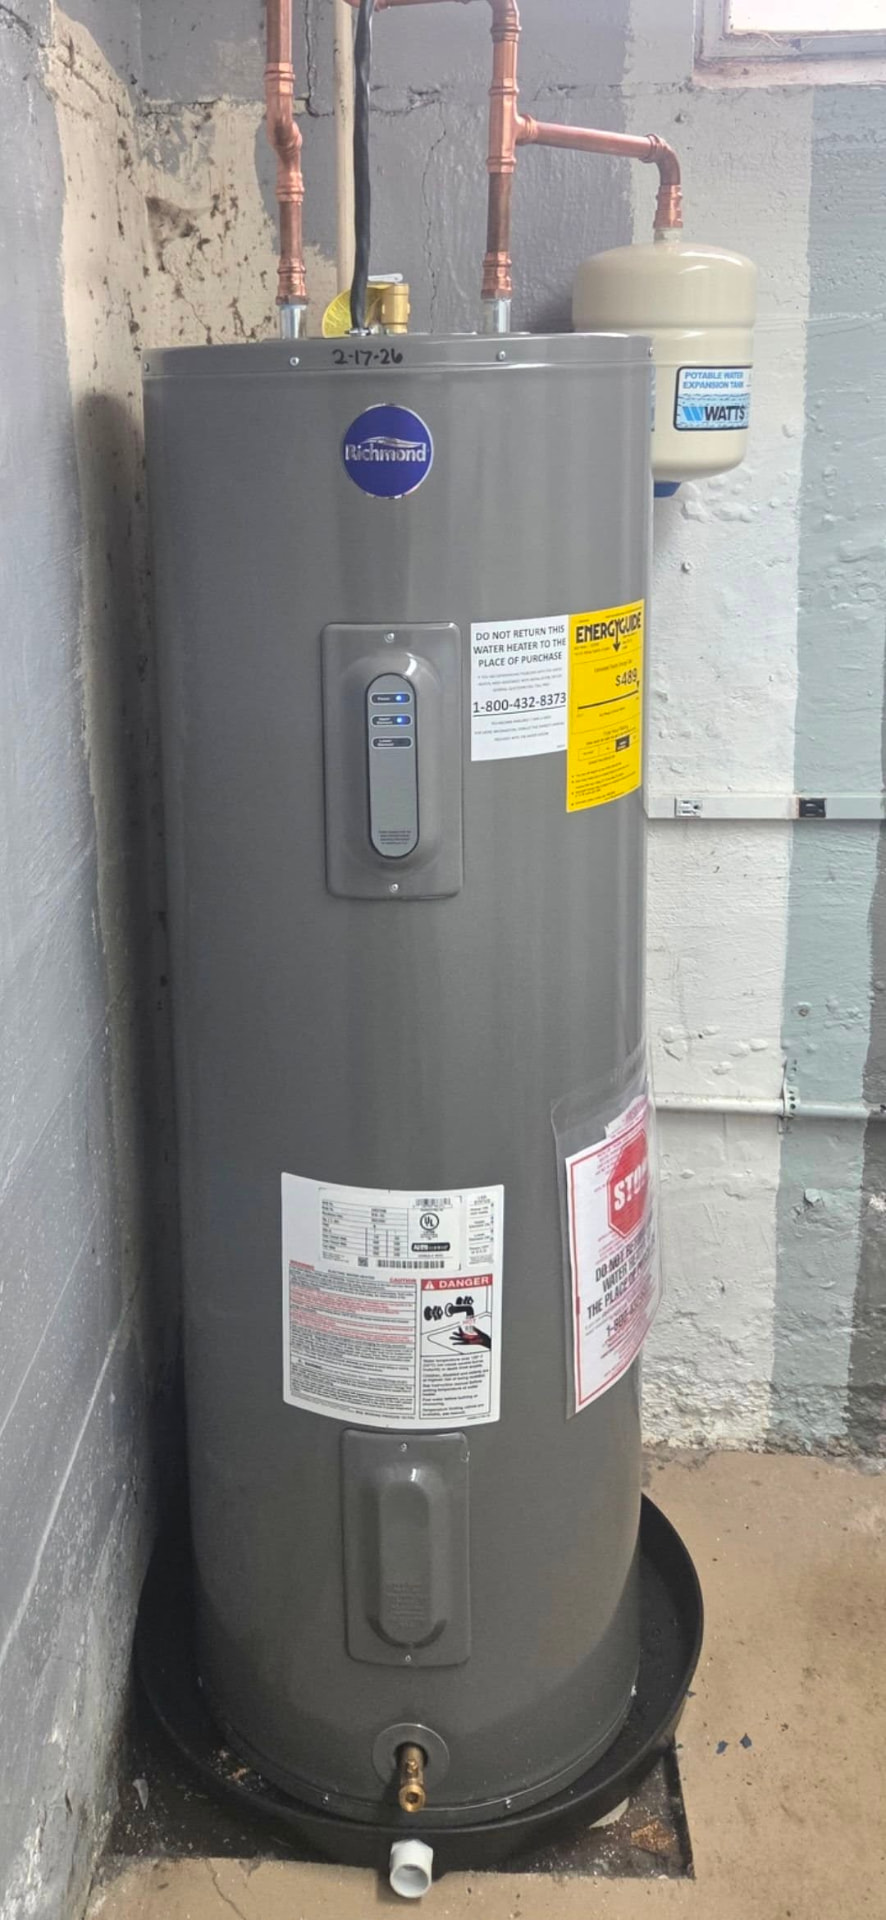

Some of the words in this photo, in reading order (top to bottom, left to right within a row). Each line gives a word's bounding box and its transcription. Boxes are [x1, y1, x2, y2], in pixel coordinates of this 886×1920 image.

[332, 348, 403, 366] 2-17-26
[704, 406, 745, 420] WATTS
[345, 443, 426, 462] Richmond
[476, 632, 490, 641] DO
[492, 630, 511, 640] NOT
[513, 628, 546, 638] RETURN
[548, 624, 564, 634] THIS
[473, 644, 504, 654] WATER
[506, 642, 538, 652] HEATER
[540, 640, 550, 648] TO
[552, 638, 566, 647] THE
[478, 658, 505, 668] PLACE
[508, 656, 520, 666] OF
[521, 652, 562, 664] PURCHASE
[615, 667, 638, 686] $489
[473, 692, 566, 714] 1-800-432-8373
[424, 1216, 434, 1227] UL
[596, 1263, 608, 1282] DO
[609, 1250, 624, 1273] NOT
[439, 1276, 490, 1288] DANGER
[602, 1261, 627, 1292] WATER
[587, 1298, 602, 1320] THE
[604, 1276, 628, 1307] PLACE
